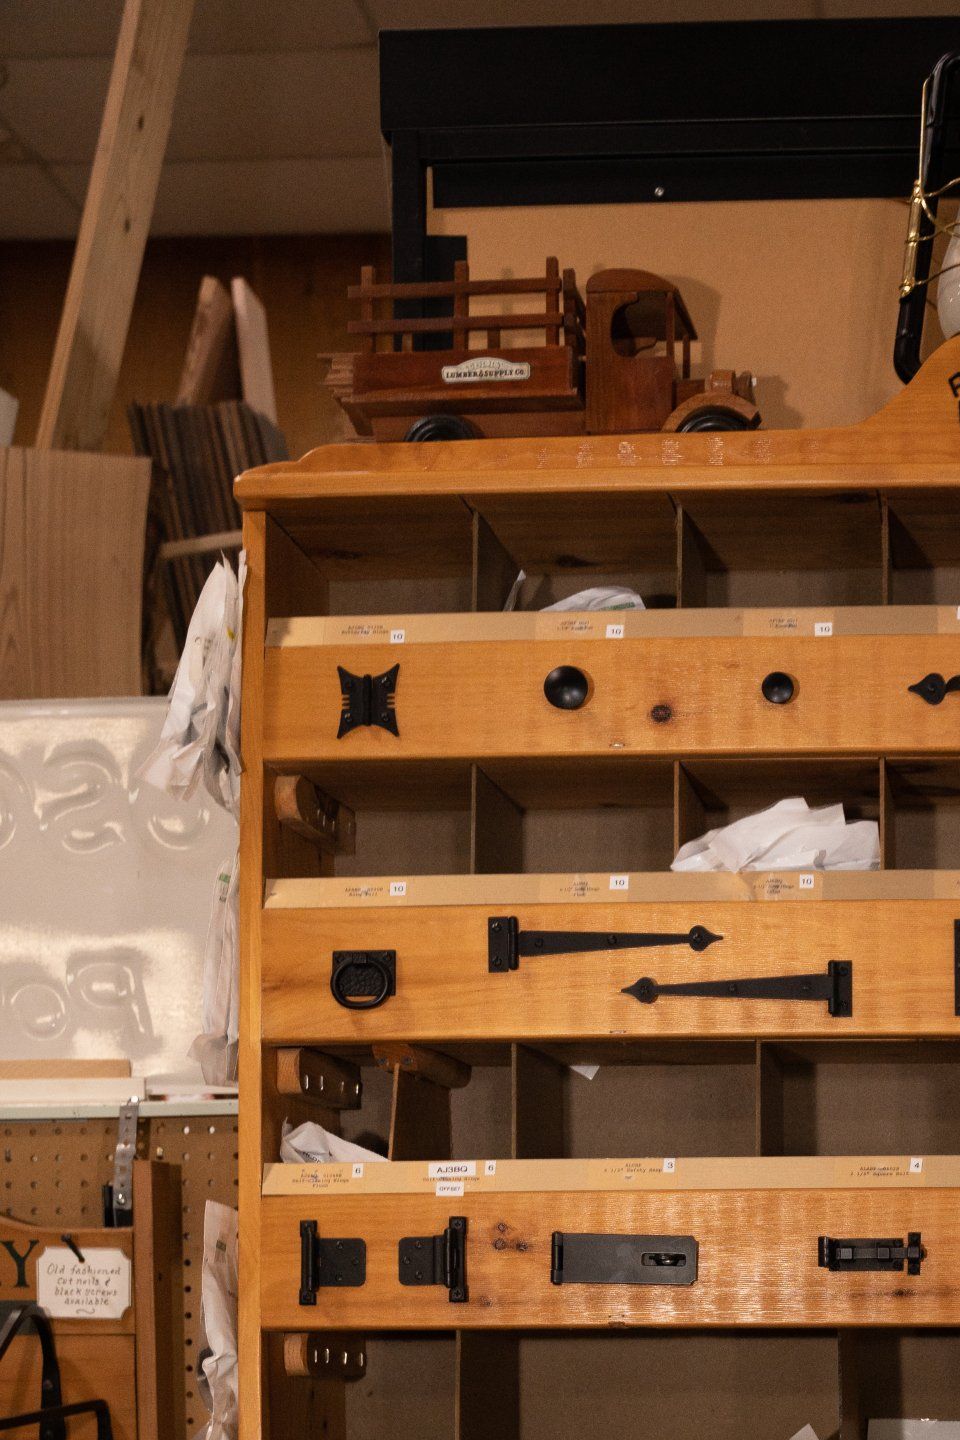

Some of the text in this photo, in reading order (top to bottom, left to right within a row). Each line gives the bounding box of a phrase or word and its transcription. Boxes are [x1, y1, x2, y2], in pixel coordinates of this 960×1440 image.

[47, 1263, 65, 1275] Old
[54, 1287, 118, 1297] black screws
[64, 1296, 109, 1306] available
